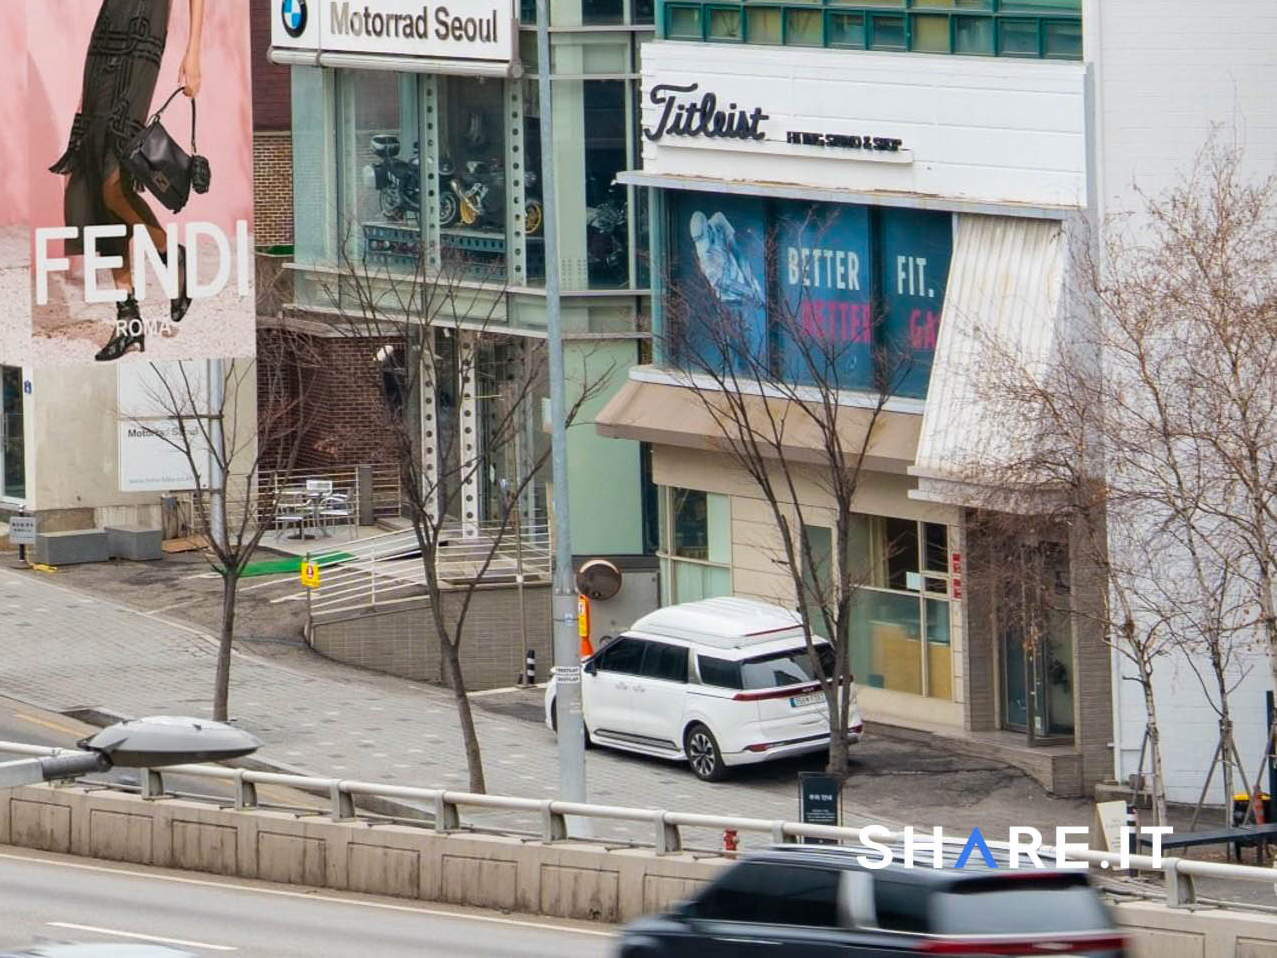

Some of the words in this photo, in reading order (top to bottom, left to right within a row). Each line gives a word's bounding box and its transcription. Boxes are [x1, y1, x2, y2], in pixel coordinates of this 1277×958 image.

[330, 1, 428, 40] Motorrad
[434, 6, 498, 43] Seoul
[643, 83, 770, 141] Titleist
[35, 219, 248, 306] FENDI
[787, 246, 860, 291] BETTER
[896, 255, 934, 298] FIT.
[115, 319, 172, 337] ROMA
